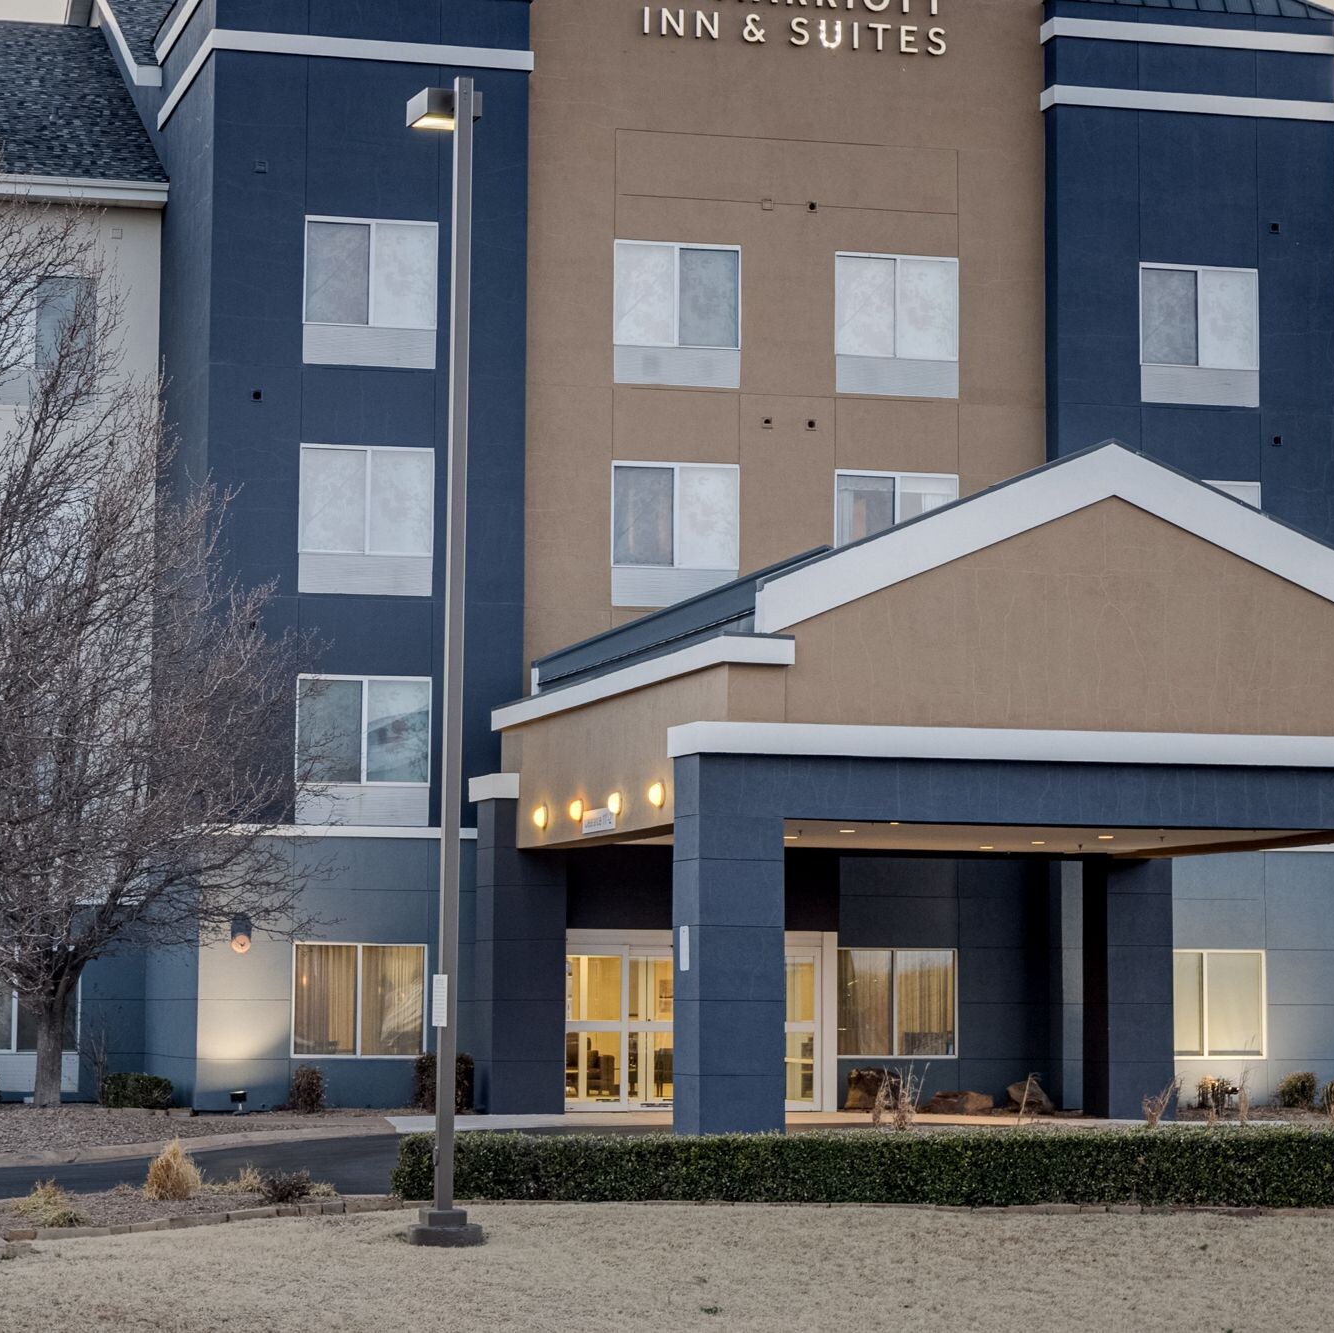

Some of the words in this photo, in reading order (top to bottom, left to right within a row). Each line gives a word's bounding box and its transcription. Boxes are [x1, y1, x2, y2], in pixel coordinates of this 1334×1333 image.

[643, 6, 719, 39] INN
[742, 13, 766, 43] &
[789, 16, 947, 56] SUITES
